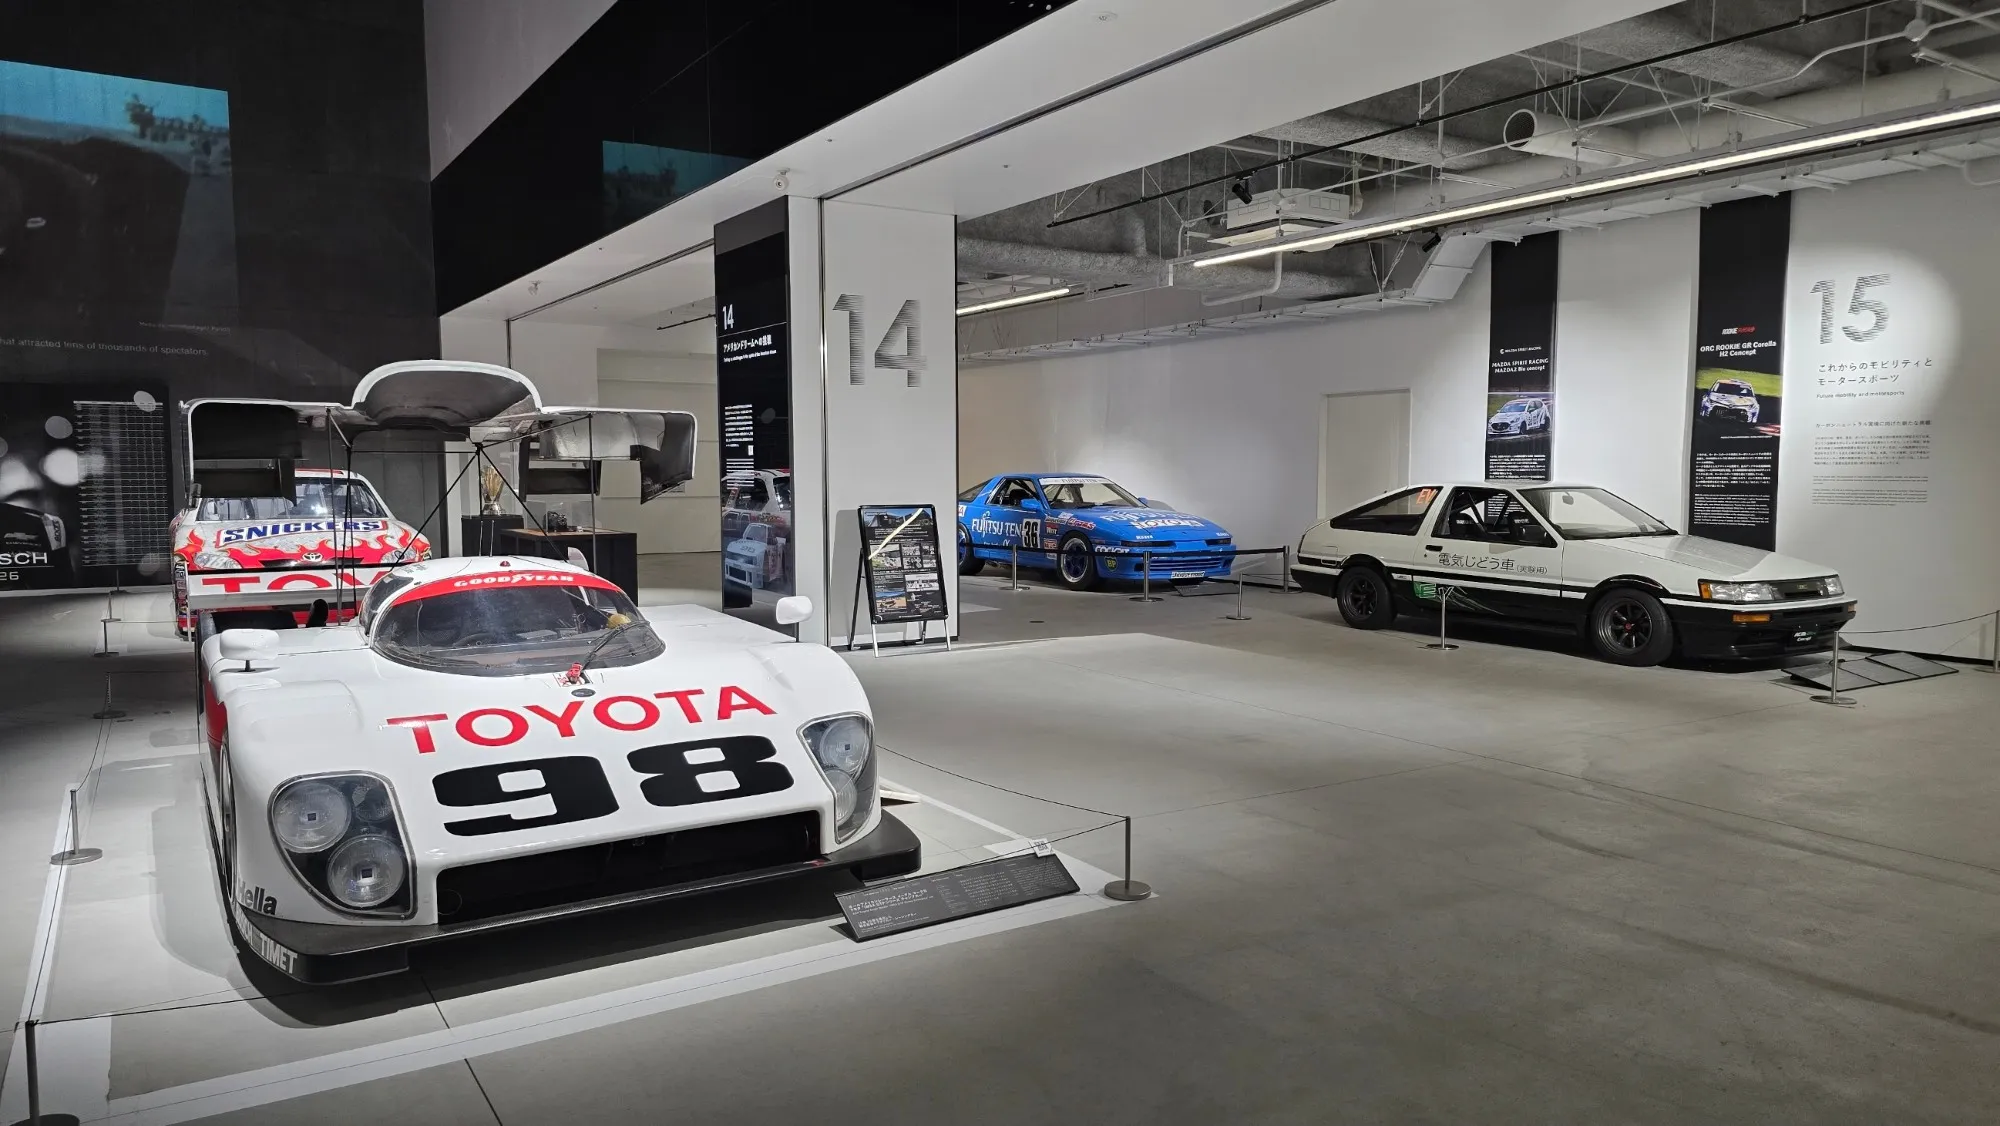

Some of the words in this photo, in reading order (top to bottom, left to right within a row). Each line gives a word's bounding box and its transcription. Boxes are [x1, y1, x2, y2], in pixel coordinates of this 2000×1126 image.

[722, 304, 735, 331] 14
[1810, 274, 1892, 345] 15
[19, 338, 60, 348] attracted
[87, 342, 96, 350] of
[98, 342, 147, 353] thousands
[149, 345, 158, 353] of
[832, 293, 927, 387] 14
[1700, 345, 1714, 353] ORC
[1716, 343, 1741, 351] ROOKIE
[1753, 340, 1777, 348] Corolla
[1730, 349, 1757, 357] Concept
[1512, 359, 1528, 367] SPIRIT
[1529, 357, 1549, 365] RACING
[1527, 364, 1546, 372] concept
[1818, 357, 1933, 374] これからのモビリティと
[1817, 373, 1900, 387] モータースポーツ
[1835, 392, 1858, 400] mobility
[1870, 390, 1905, 398] motorsports
[223, 519, 381, 543] SNICKERS
[971, 514, 1003, 538] FUJITSU
[1005, 521, 1021, 538] TEN
[1024, 520, 1039, 548] 36
[0, 552, 48, 565] SCH
[1107, 559, 1116, 568] BP
[1438, 552, 1515, 571] 電気じどう車
[453, 573, 574, 588] GOODYEAR
[386, 685, 777, 754] TOYOTA
[432, 735, 795, 837] 98
[260, 933, 298, 974] TIMET
